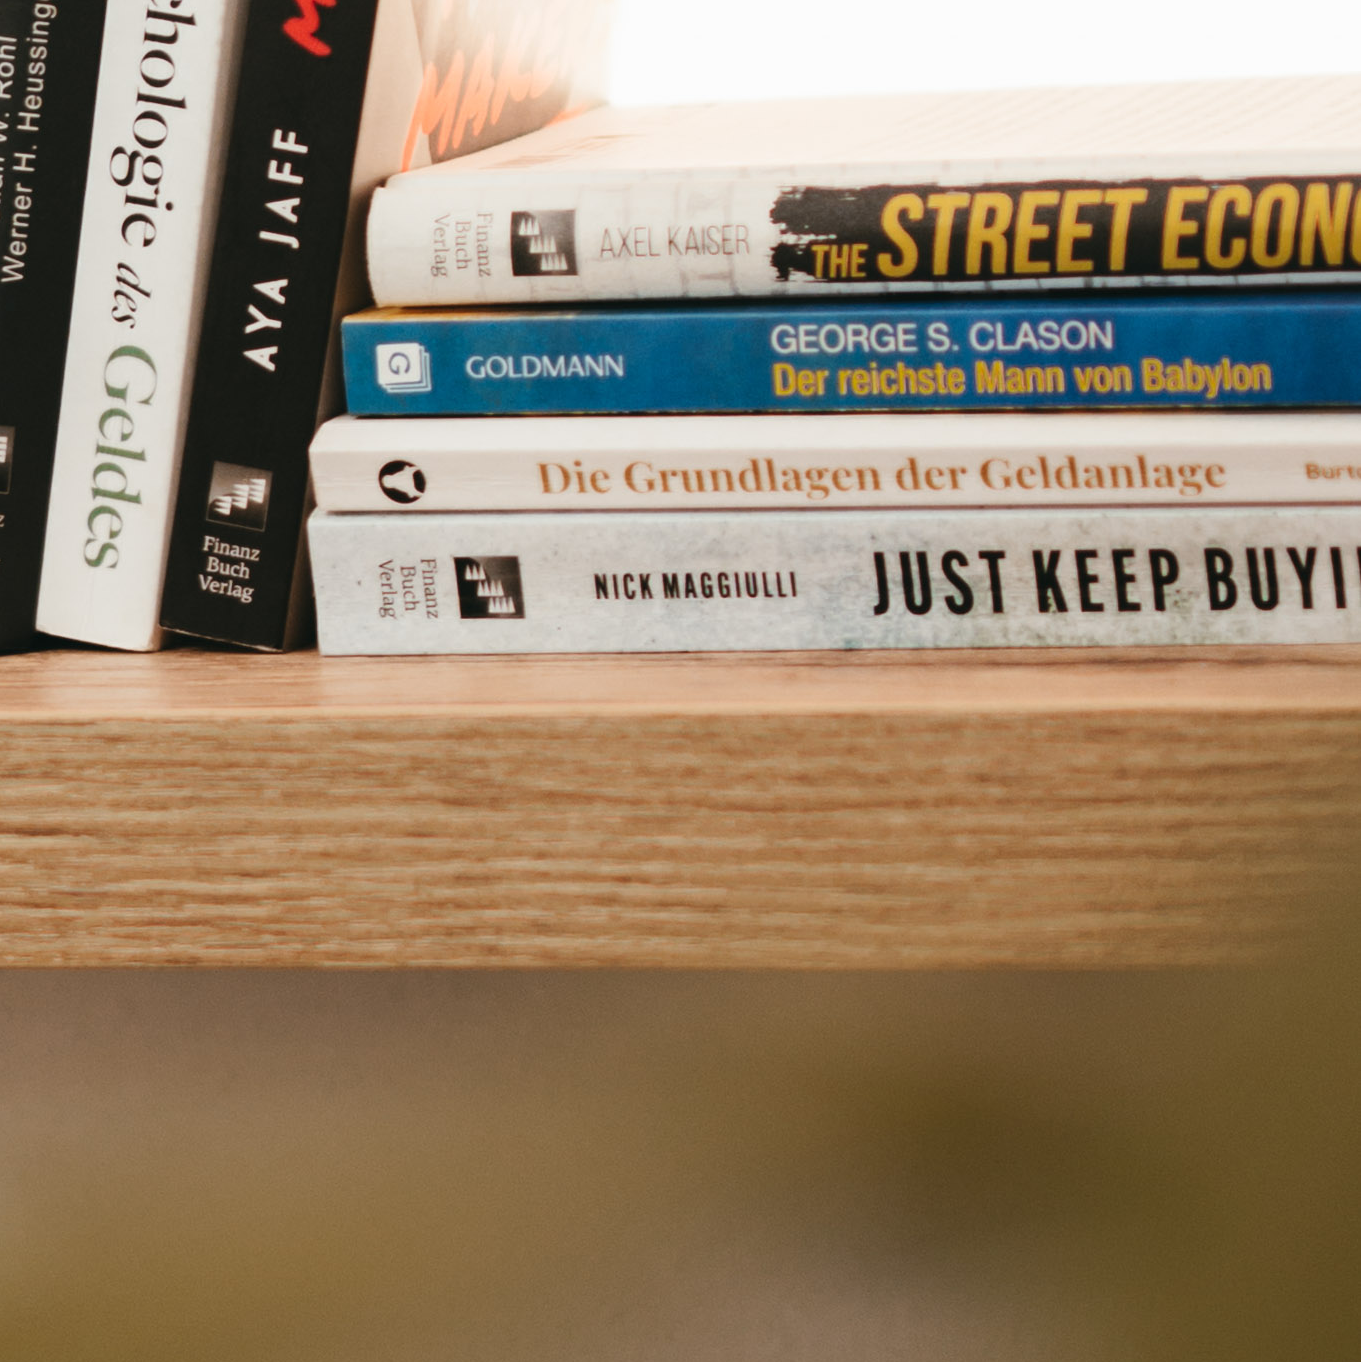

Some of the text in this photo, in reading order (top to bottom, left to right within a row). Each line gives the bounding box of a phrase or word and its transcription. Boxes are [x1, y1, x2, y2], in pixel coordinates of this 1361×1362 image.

[13, 146, 37, 171] H.
[243, 129, 309, 371] AYA JAFF
[430, 213, 453, 278] Verlag
[456, 222, 472, 270] Buch
[476, 211, 494, 278] Finanz
[600, 225, 749, 258] AXEL KAISER
[810, 182, 1361, 280] THE STREET ECON
[112, 263, 150, 328] des
[771, 321, 1112, 354] GEORGE S. CLASON
[466, 355, 623, 378] GOLDMANN
[774, 358, 1271, 399] Der reichste Mann von Babylon
[82, 346, 160, 573] Geldes
[539, 455, 1224, 497] Die Grundlagen der Geldanlage
[203, 536, 260, 563] Finanz
[207, 555, 253, 580] Buch
[199, 571, 254, 603] Verlag
[379, 560, 397, 617] Verlag
[400, 566, 418, 611] Buch
[420, 559, 438, 618] Finanz
[595, 572, 796, 599] NICK MAGGIULLI
[874, 547, 1361, 615] JUST KEEP BUYI
